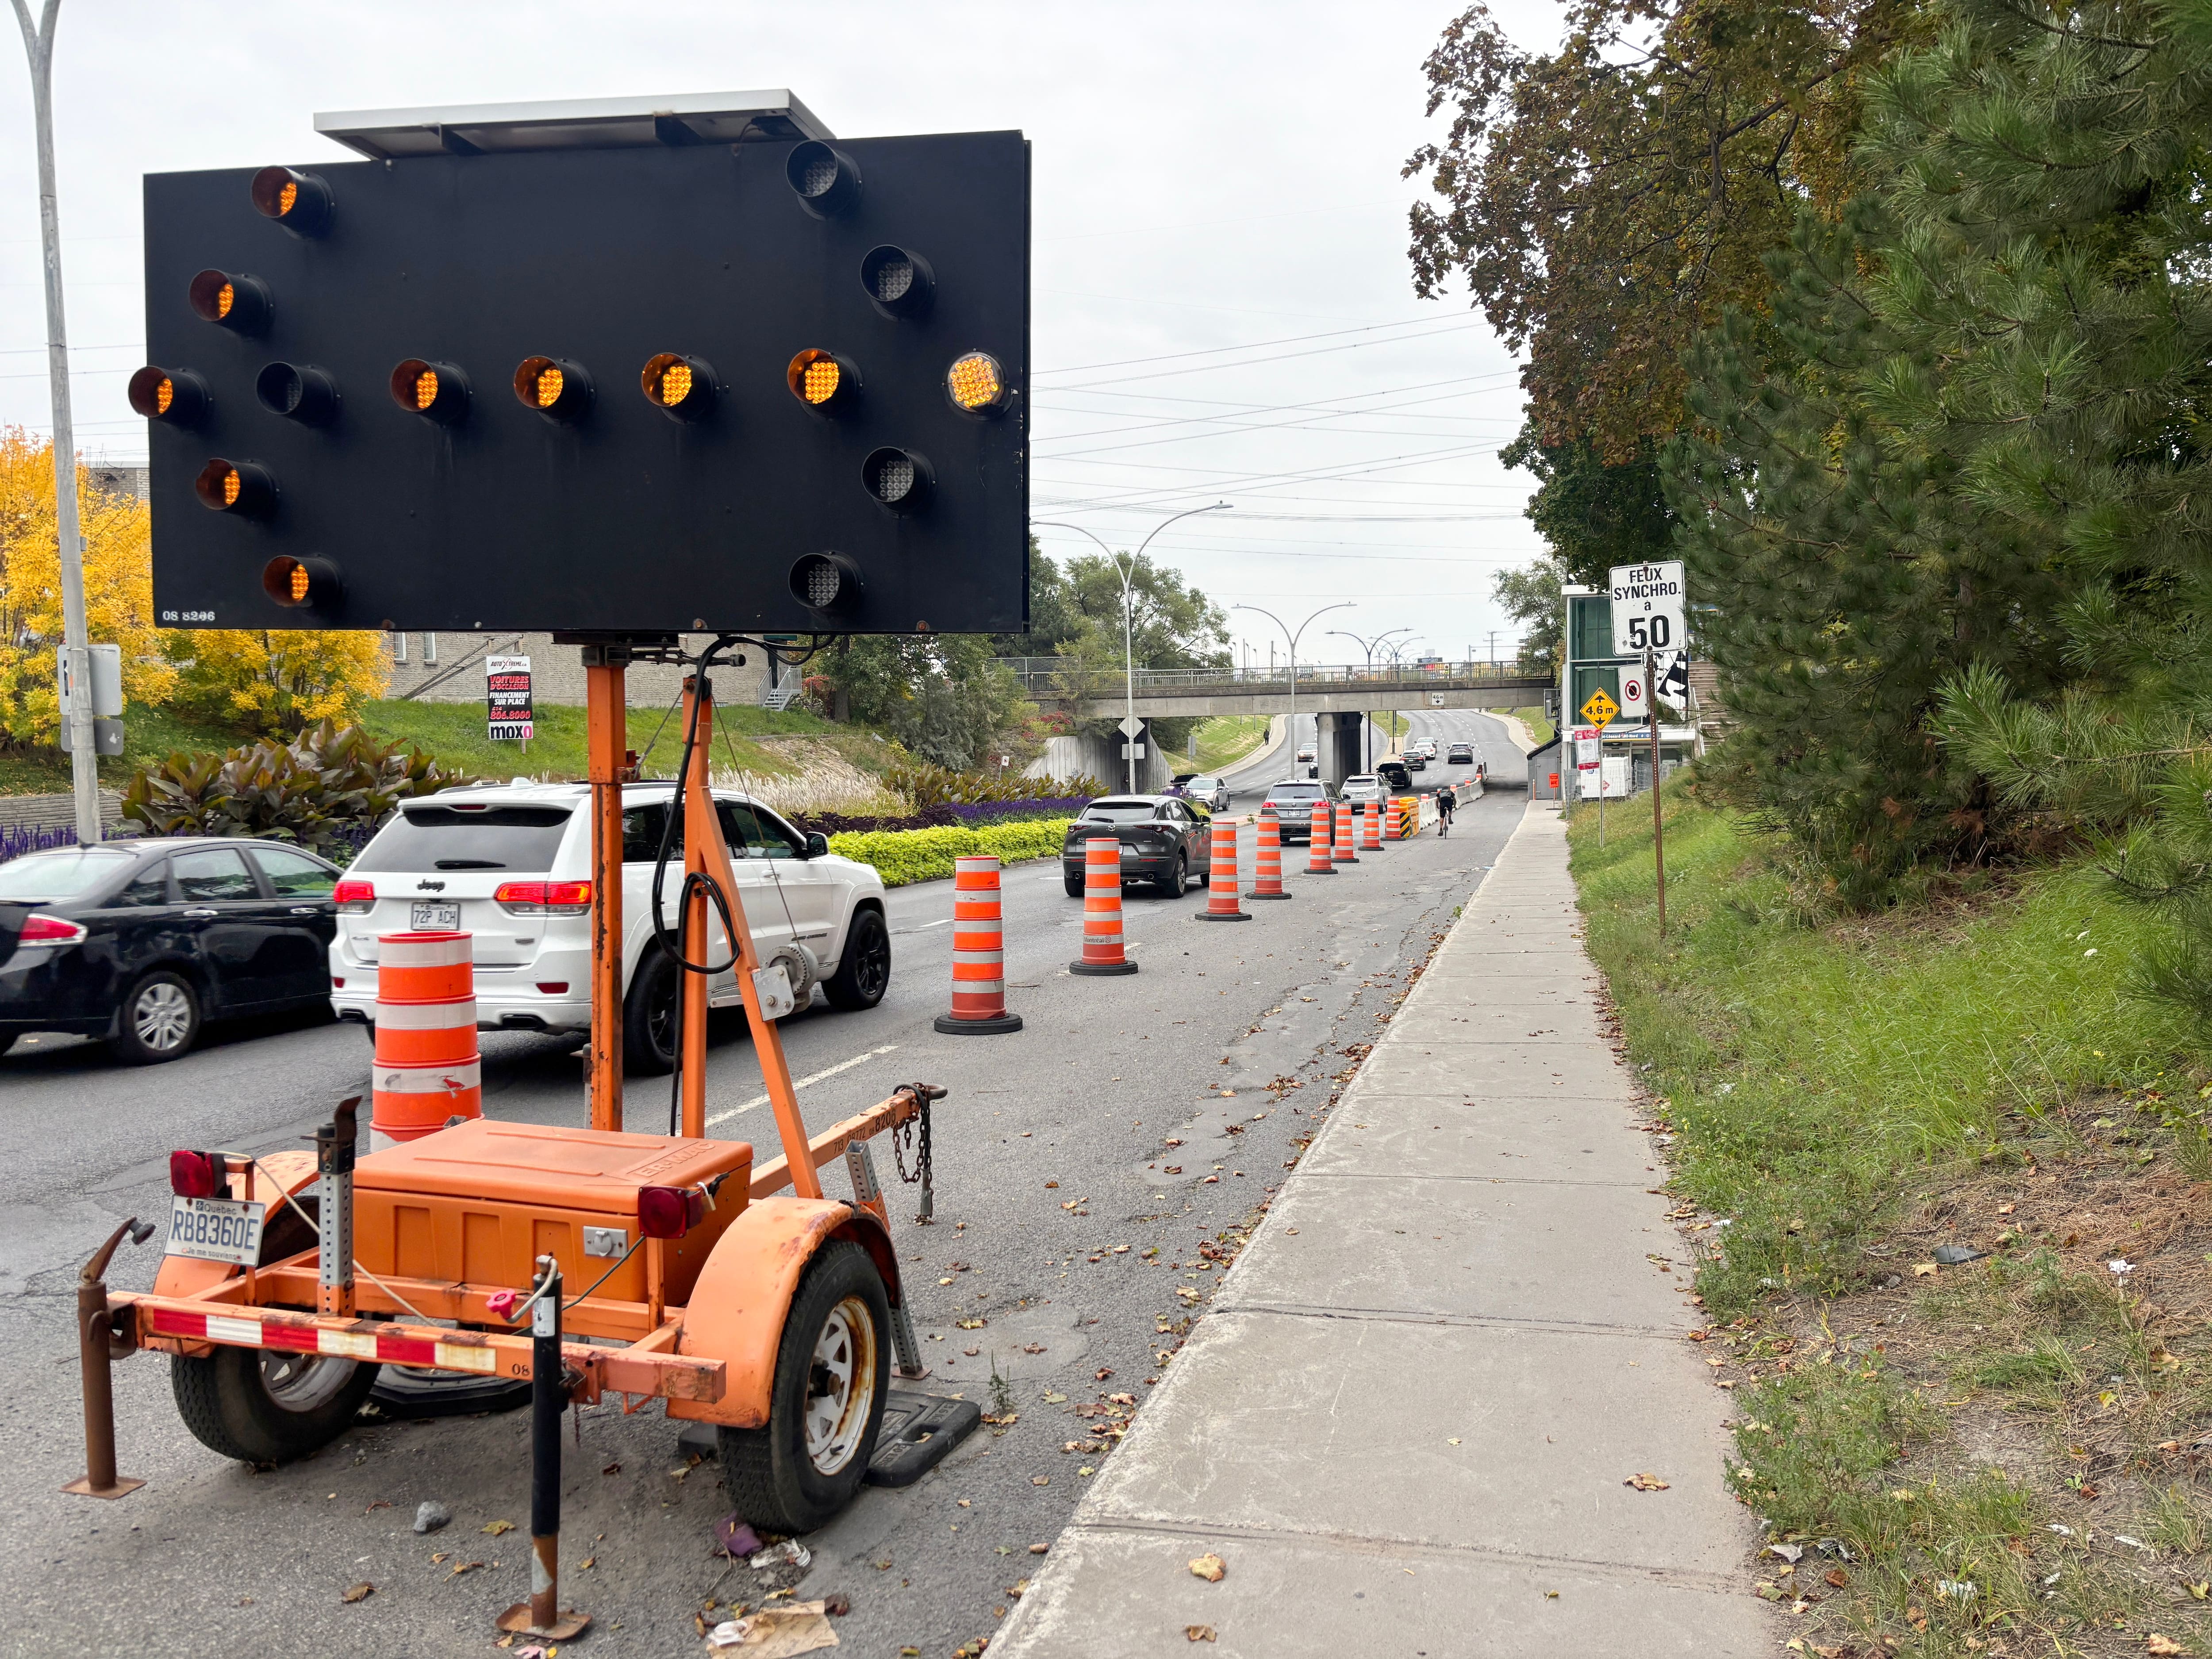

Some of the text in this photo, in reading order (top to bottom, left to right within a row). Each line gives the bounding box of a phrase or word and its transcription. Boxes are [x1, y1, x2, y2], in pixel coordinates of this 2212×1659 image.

[1629, 567, 1662, 583] FEUX
[1614, 582, 1681, 600] SYNCHRO.
[162, 611, 179, 621] 08
[1629, 615, 1670, 649] 50
[1586, 705, 1603, 715] 4,6
[491, 726, 533, 739] moxo
[417, 879, 445, 892] Jeep
[415, 910, 432, 923] 72P
[833, 1139, 844, 1154] 713
[876, 1108, 896, 1132] 8206
[204, 1203, 237, 1215] Québec
[171, 1210, 259, 1250] RB8360E
[512, 1363, 530, 1376] 08
